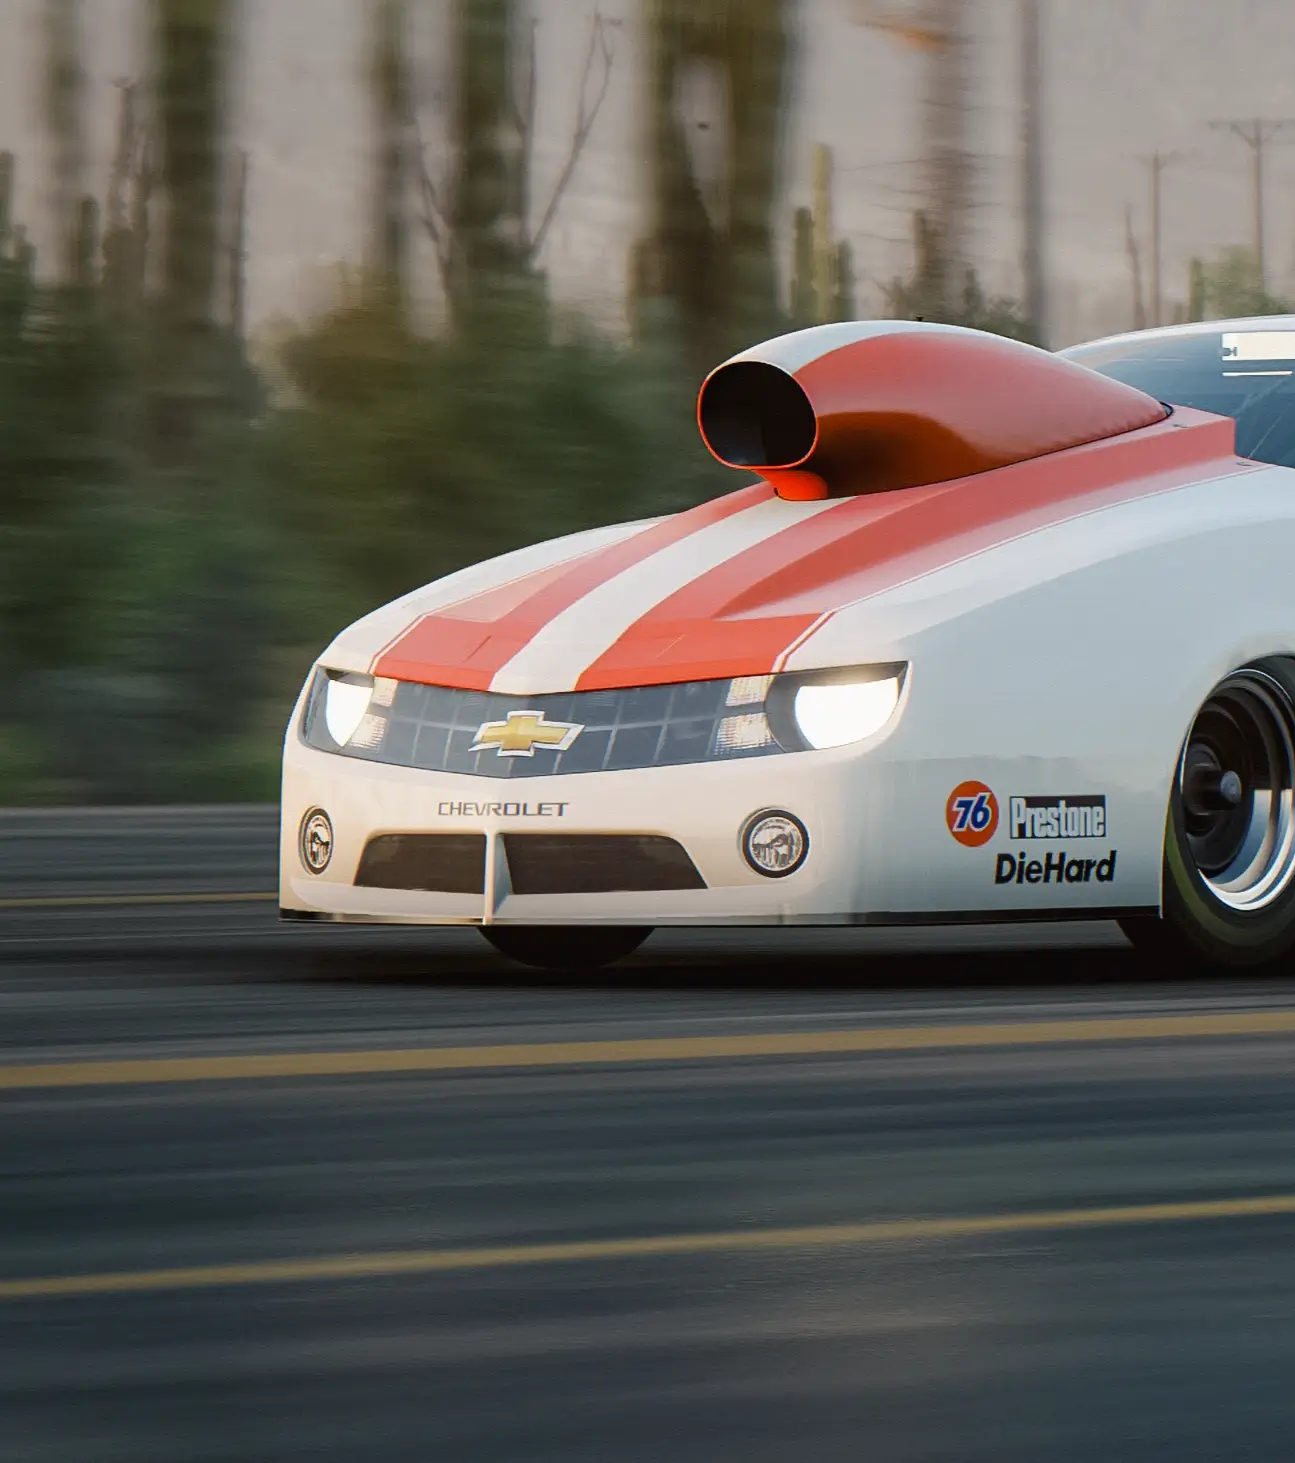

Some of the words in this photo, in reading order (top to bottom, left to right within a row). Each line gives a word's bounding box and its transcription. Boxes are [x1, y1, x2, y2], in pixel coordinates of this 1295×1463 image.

[438, 802, 569, 817] CHEVROLET
[952, 792, 991, 832] 76
[1011, 797, 1105, 838] Prestone
[994, 850, 1117, 884] DieHard
